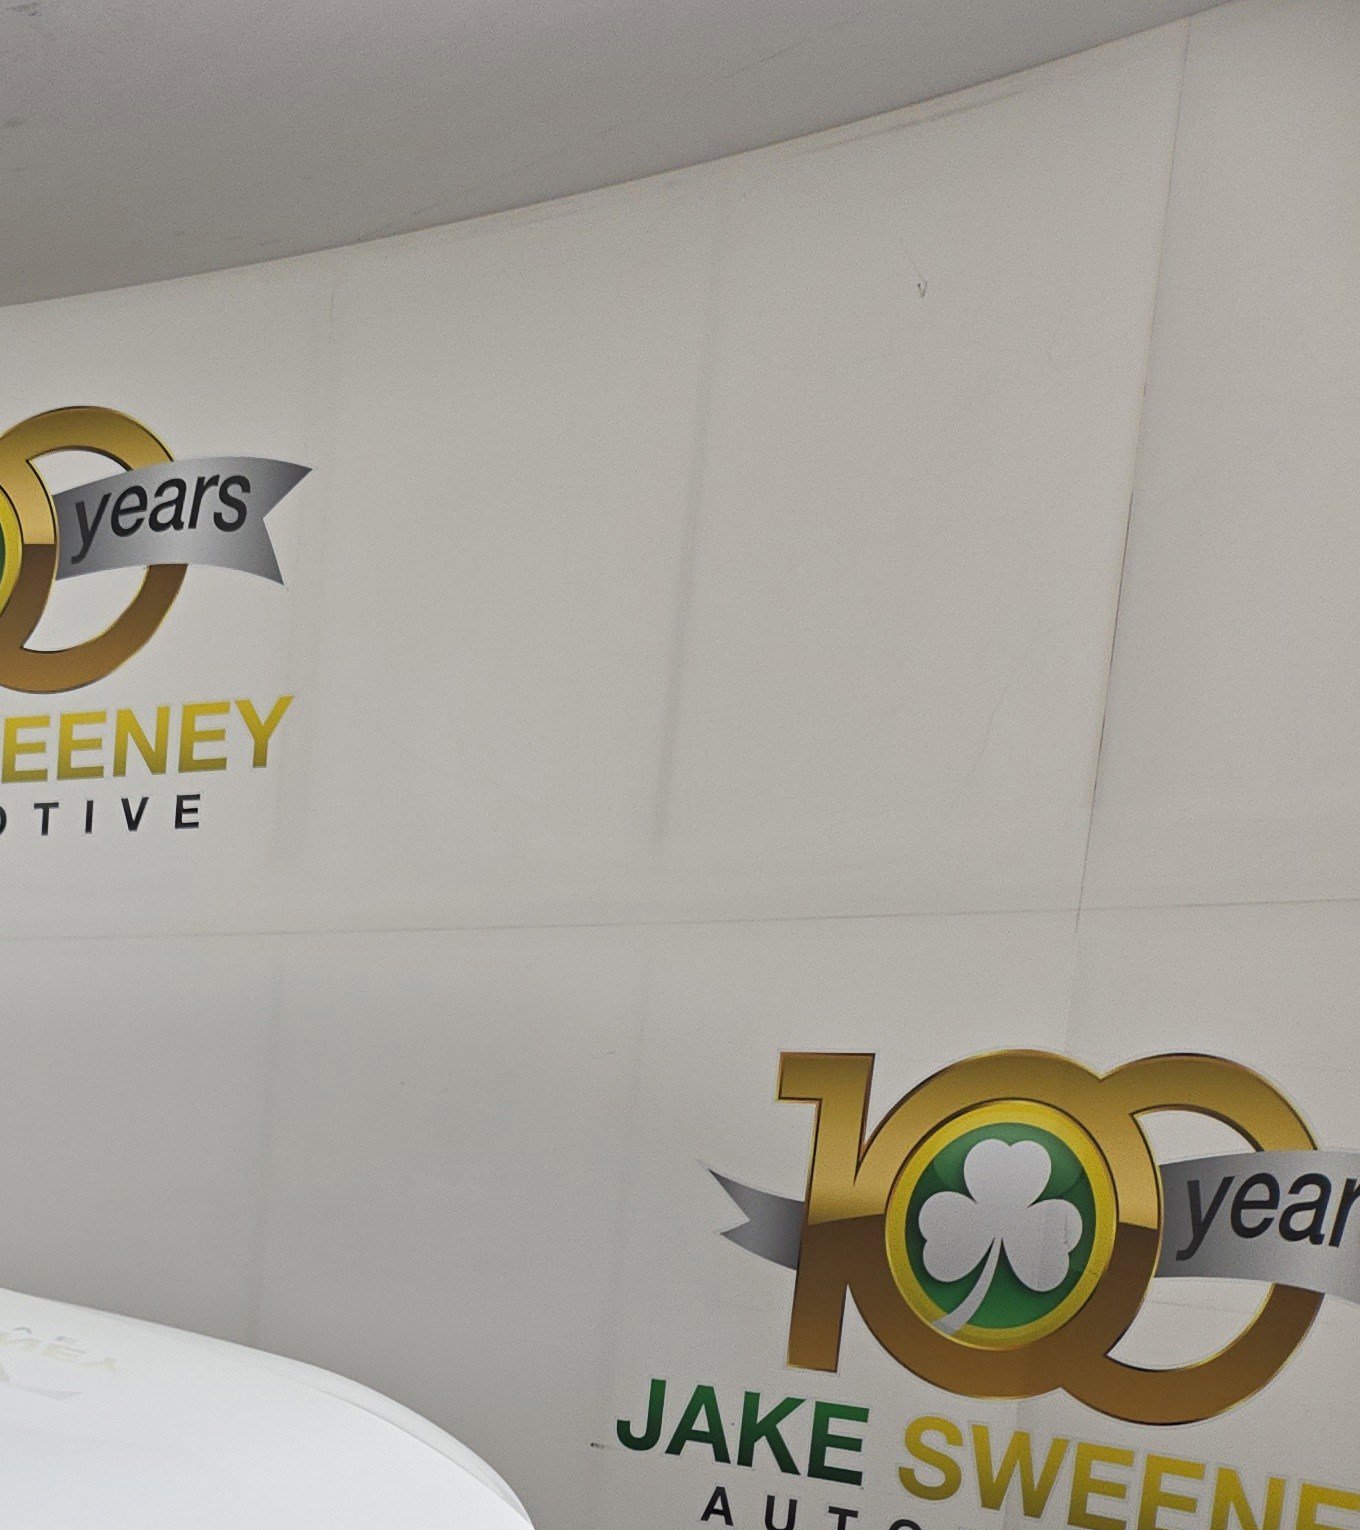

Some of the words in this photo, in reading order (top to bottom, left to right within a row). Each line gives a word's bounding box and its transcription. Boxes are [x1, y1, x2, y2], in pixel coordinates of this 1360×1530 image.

[70, 472, 253, 564] years
[777, 1049, 1326, 1427] 100
[616, 1377, 871, 1487] JAKE
